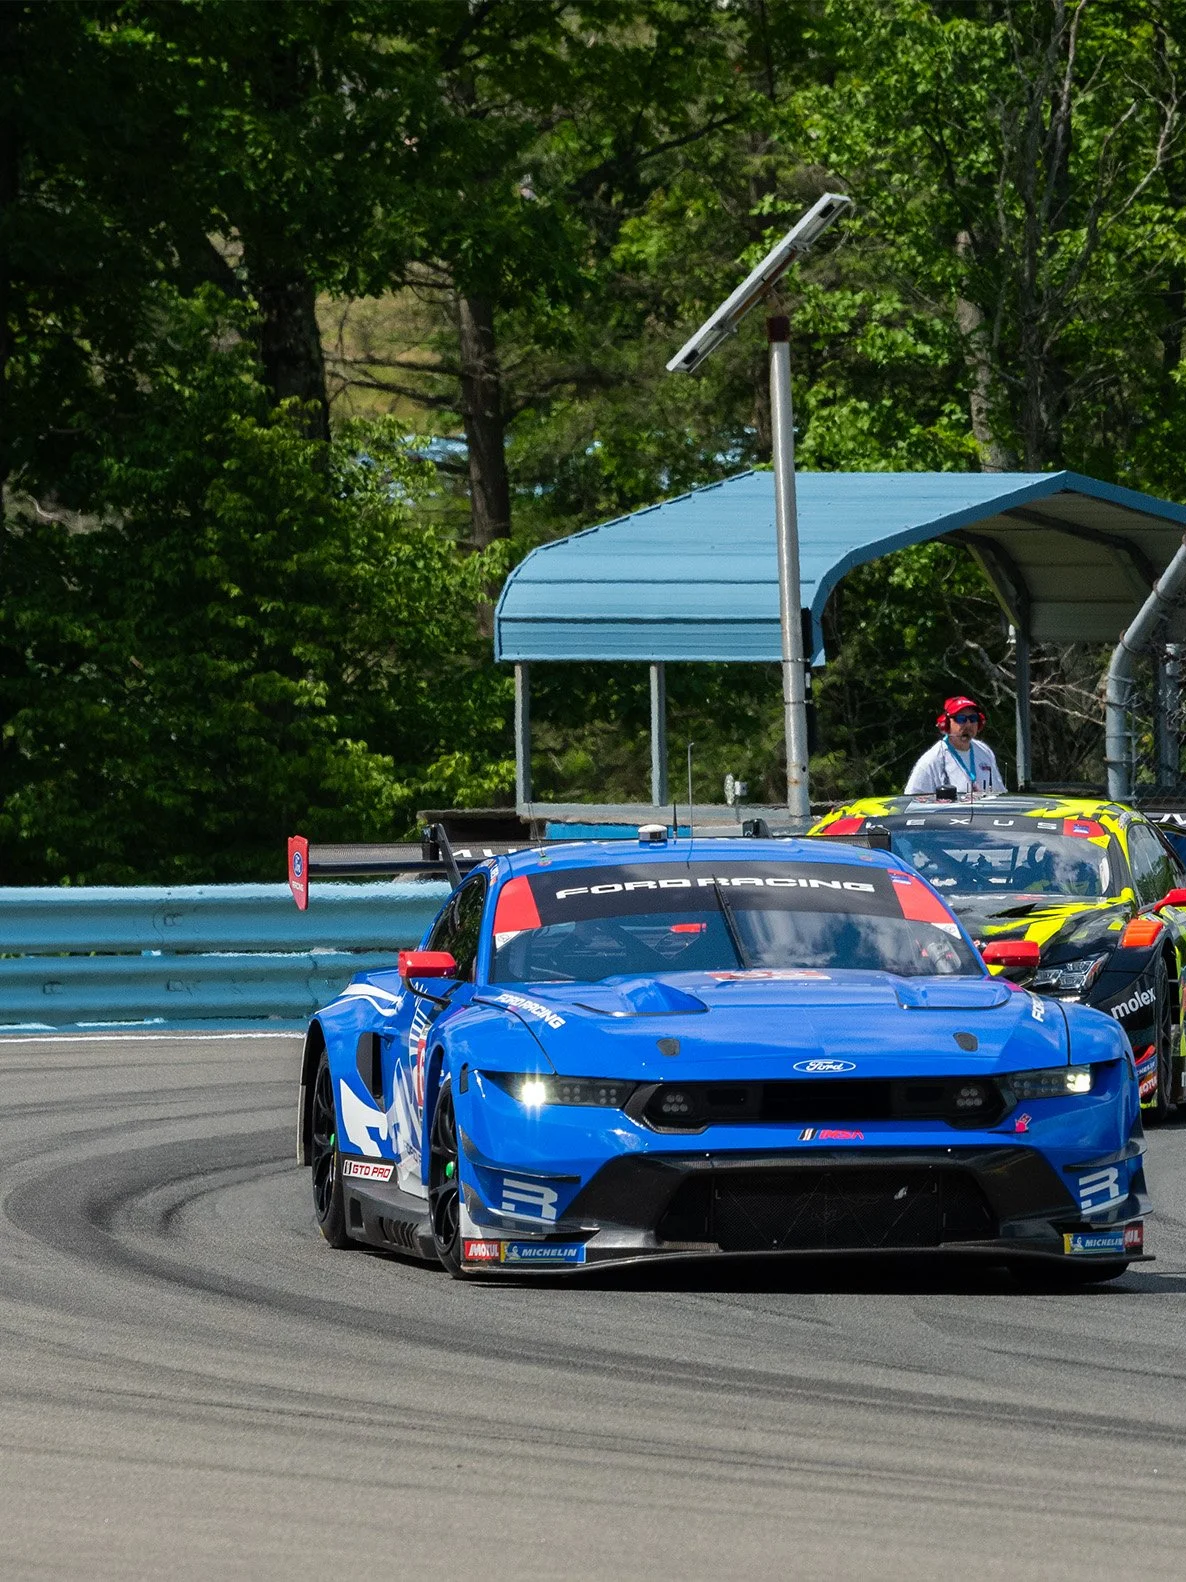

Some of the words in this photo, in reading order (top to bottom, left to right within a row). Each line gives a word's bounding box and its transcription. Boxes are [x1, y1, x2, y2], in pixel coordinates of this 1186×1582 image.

[866, 818, 1057, 830] EXUS
[556, 878, 691, 899] FORD
[698, 877, 876, 893] RACING
[1110, 986, 1157, 1020] molex
[519, 1000, 567, 1030] RACING
[805, 1059, 844, 1072] Ford
[352, 1163, 371, 1176] GTD
[370, 1166, 392, 1179] PRO
[468, 1243, 500, 1257] MOTUL
[521, 1247, 578, 1257] MICHELIN
